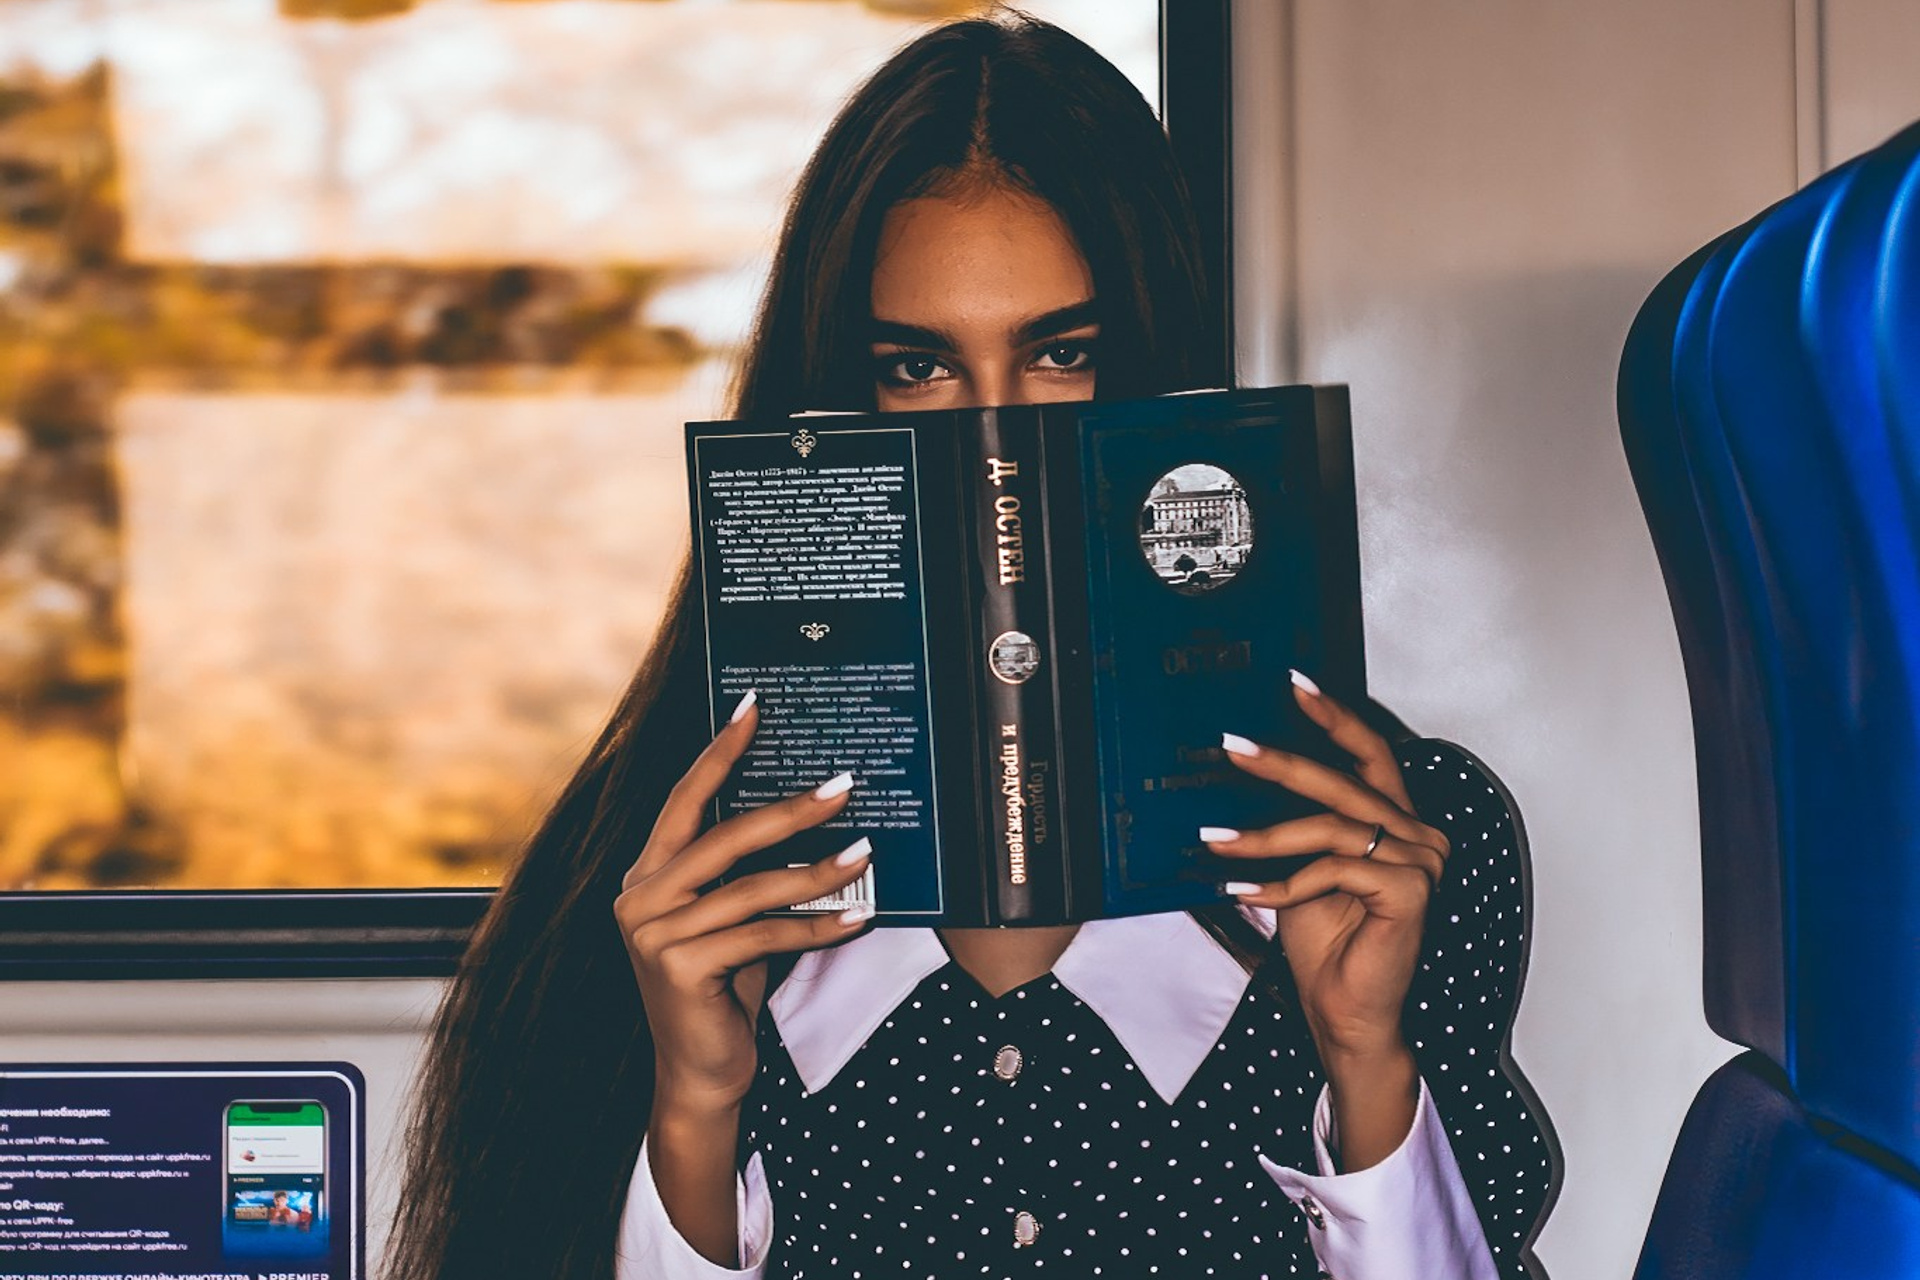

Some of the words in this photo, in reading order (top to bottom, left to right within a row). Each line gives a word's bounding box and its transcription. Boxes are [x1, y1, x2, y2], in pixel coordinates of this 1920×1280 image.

[986, 458, 1018, 486] Д.
[994, 496, 1024, 585] ОСТЕН
[1001, 723, 1017, 737] и
[1000, 743, 1026, 884] предубеждение
[1027, 760, 1048, 844] Гордость
